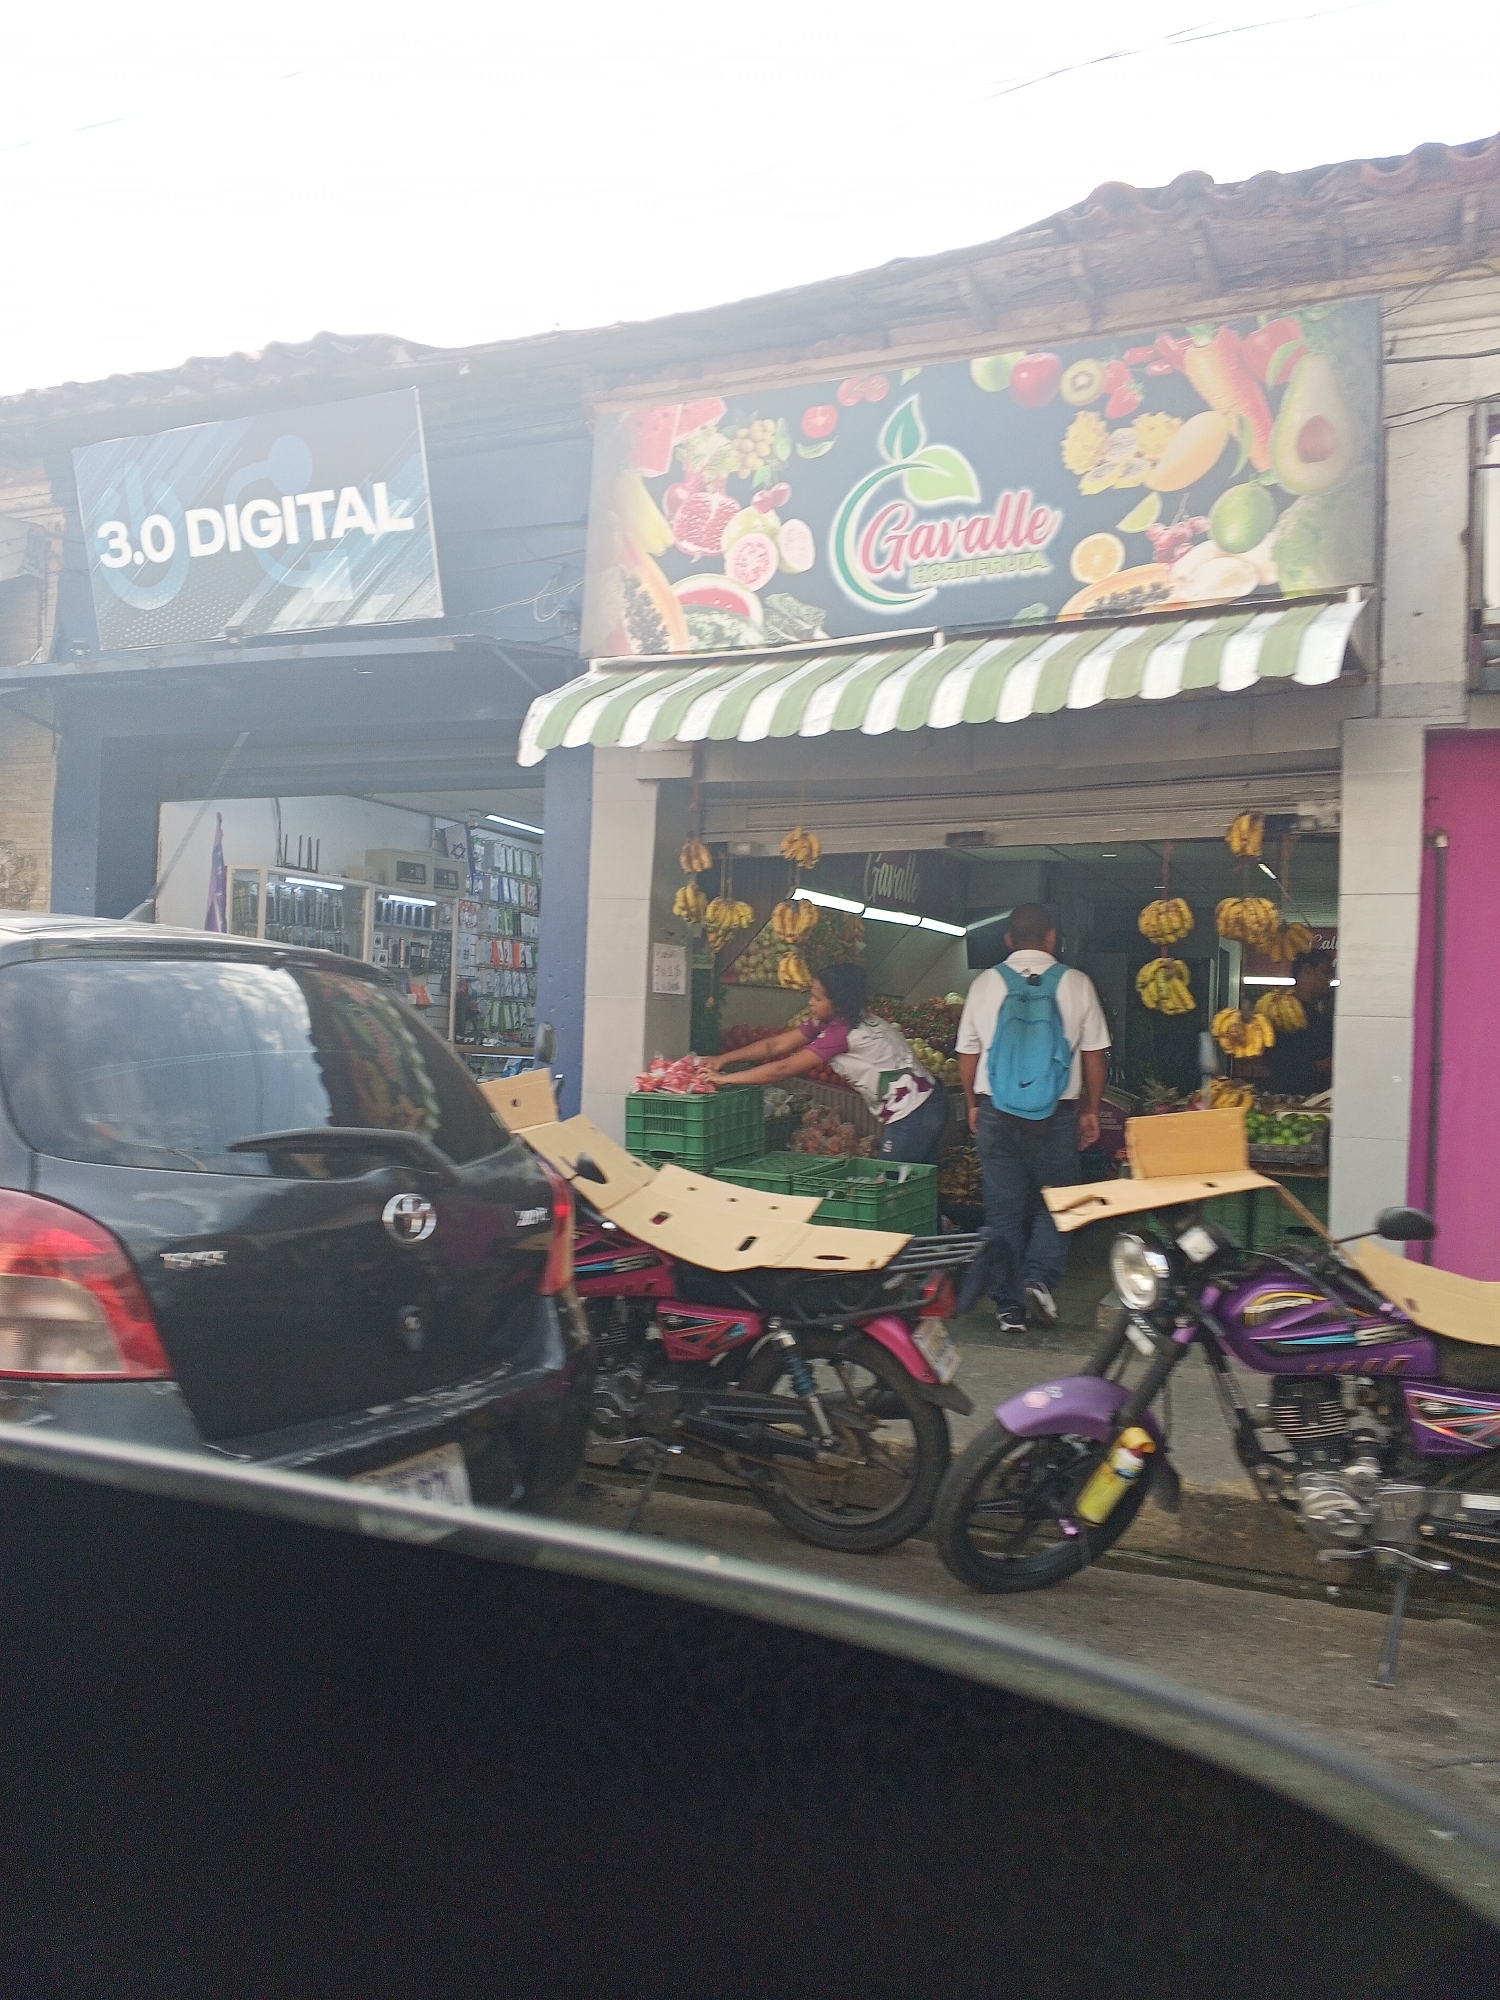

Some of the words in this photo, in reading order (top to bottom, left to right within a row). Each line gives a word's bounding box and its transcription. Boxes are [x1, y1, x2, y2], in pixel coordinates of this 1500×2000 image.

[97, 514, 176, 568] 3.0
[185, 482, 415, 558] DIGITAL
[861, 490, 1061, 575] Gavalle
